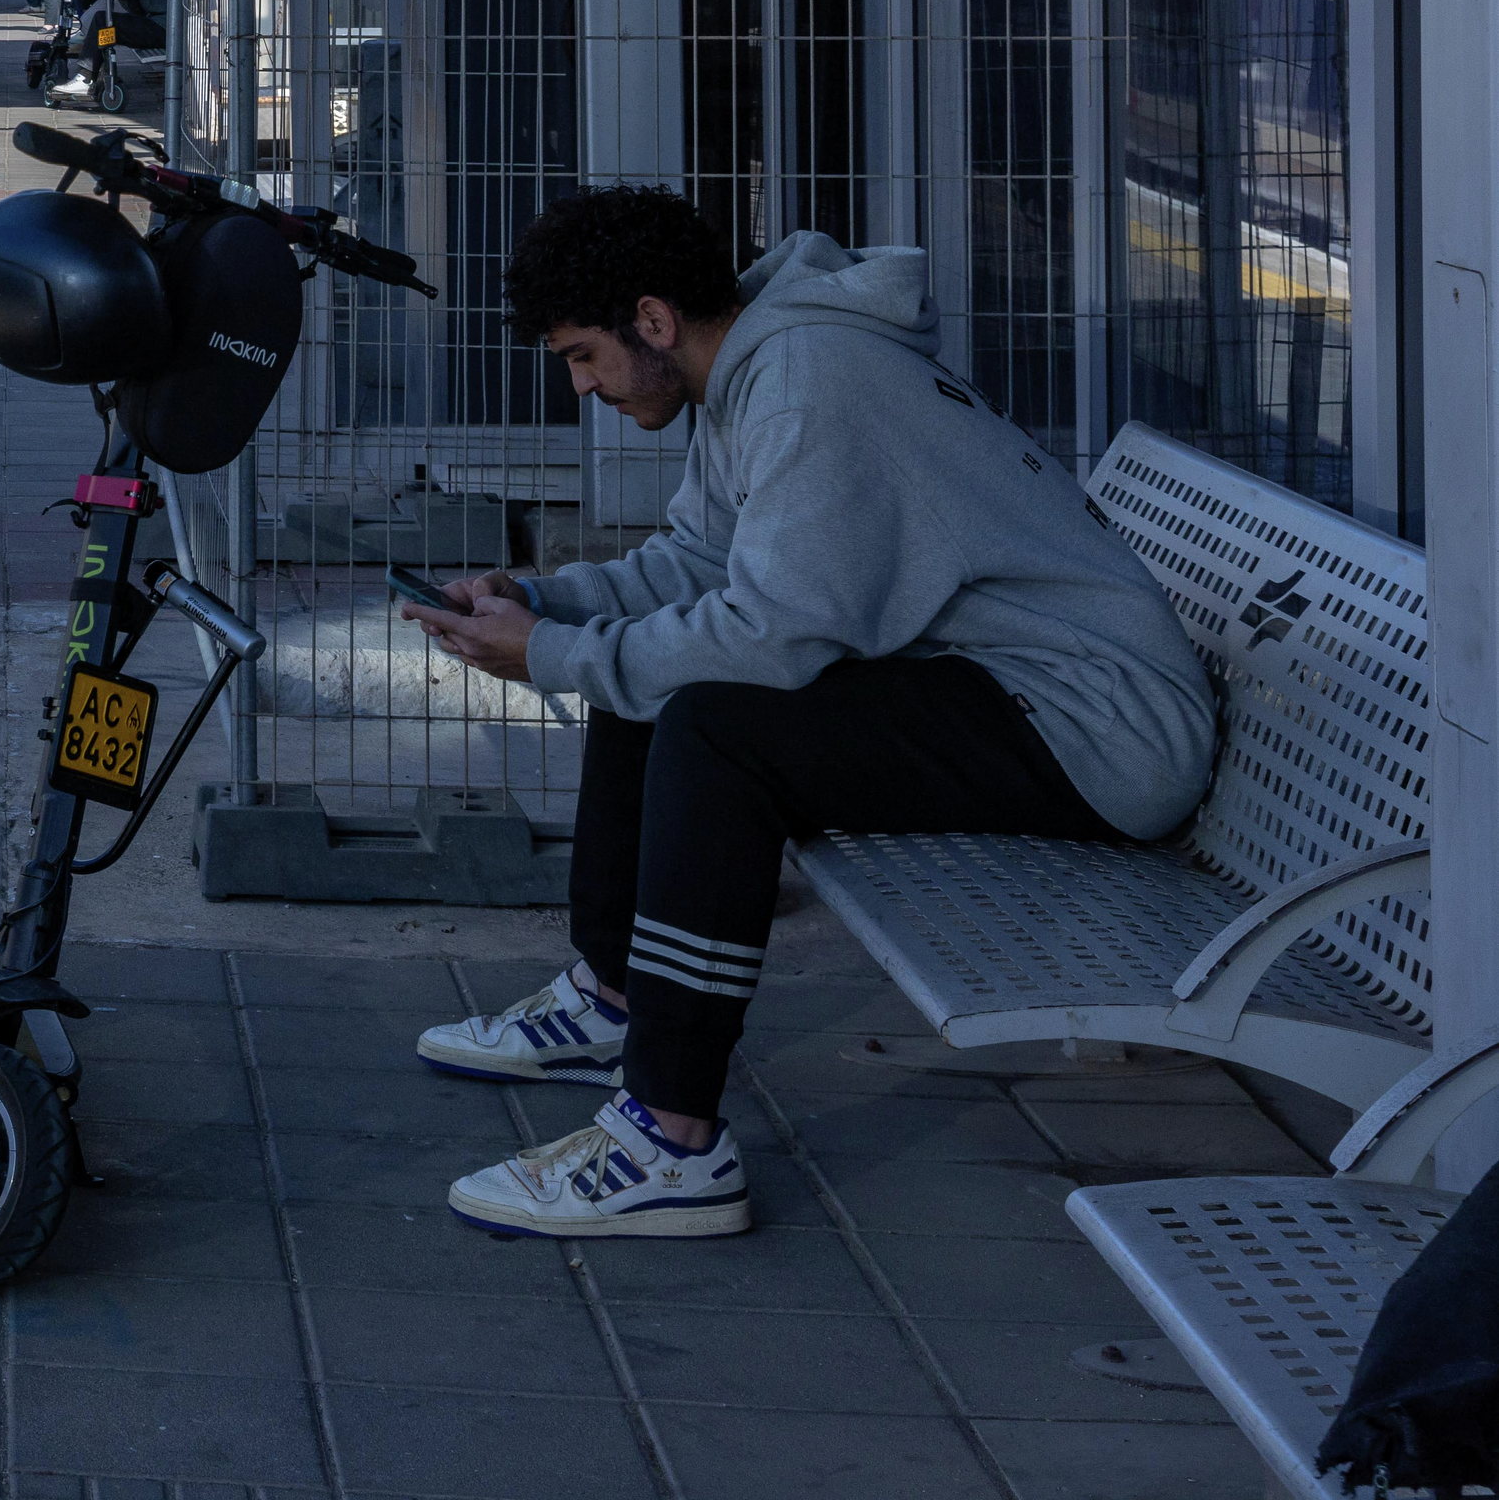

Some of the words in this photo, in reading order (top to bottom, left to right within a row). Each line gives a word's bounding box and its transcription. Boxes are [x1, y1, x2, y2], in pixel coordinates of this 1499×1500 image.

[208, 331, 277, 368] INOKIM
[182, 601, 228, 640] KRYPTONITE
[79, 686, 123, 729] AC
[65, 725, 137, 778] 8432
